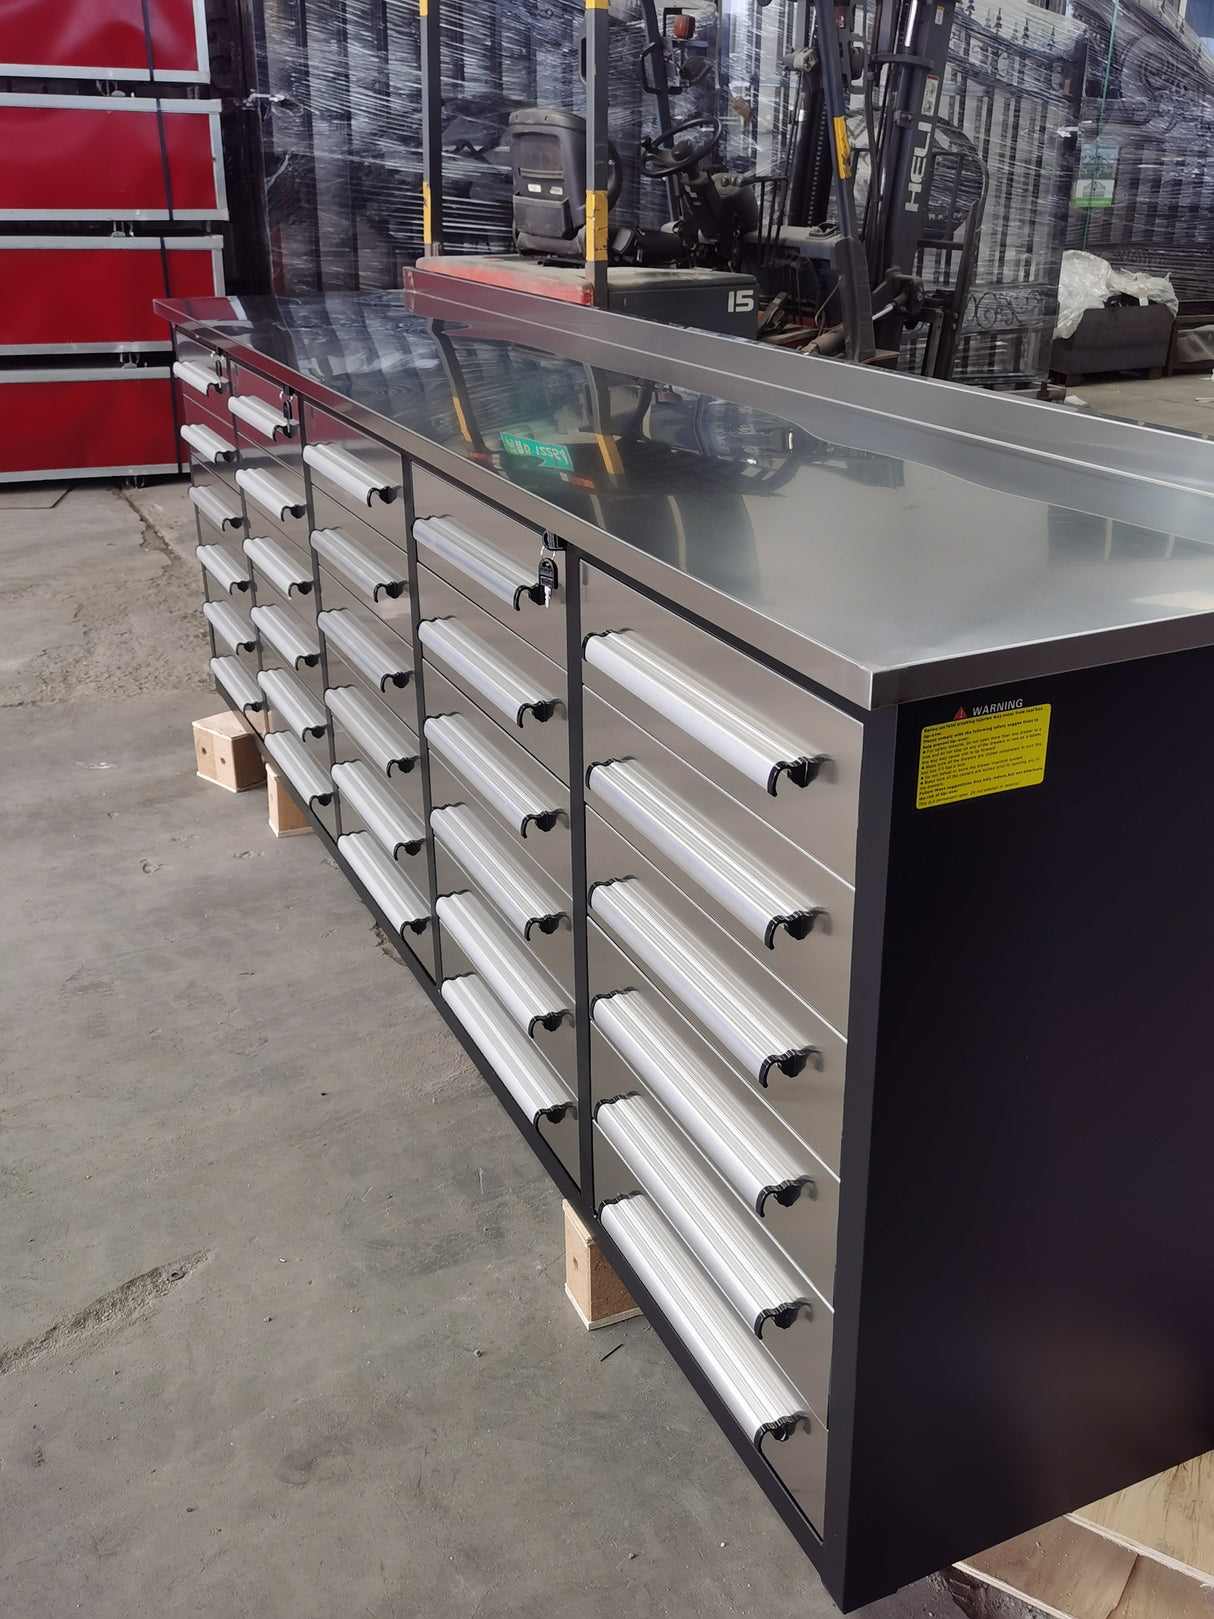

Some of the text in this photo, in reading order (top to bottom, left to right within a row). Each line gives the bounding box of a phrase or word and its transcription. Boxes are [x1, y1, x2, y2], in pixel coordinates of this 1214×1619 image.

[905, 121, 932, 212] HELI
[727, 289, 754, 312] 15
[972, 698, 1023, 716] WARNING
